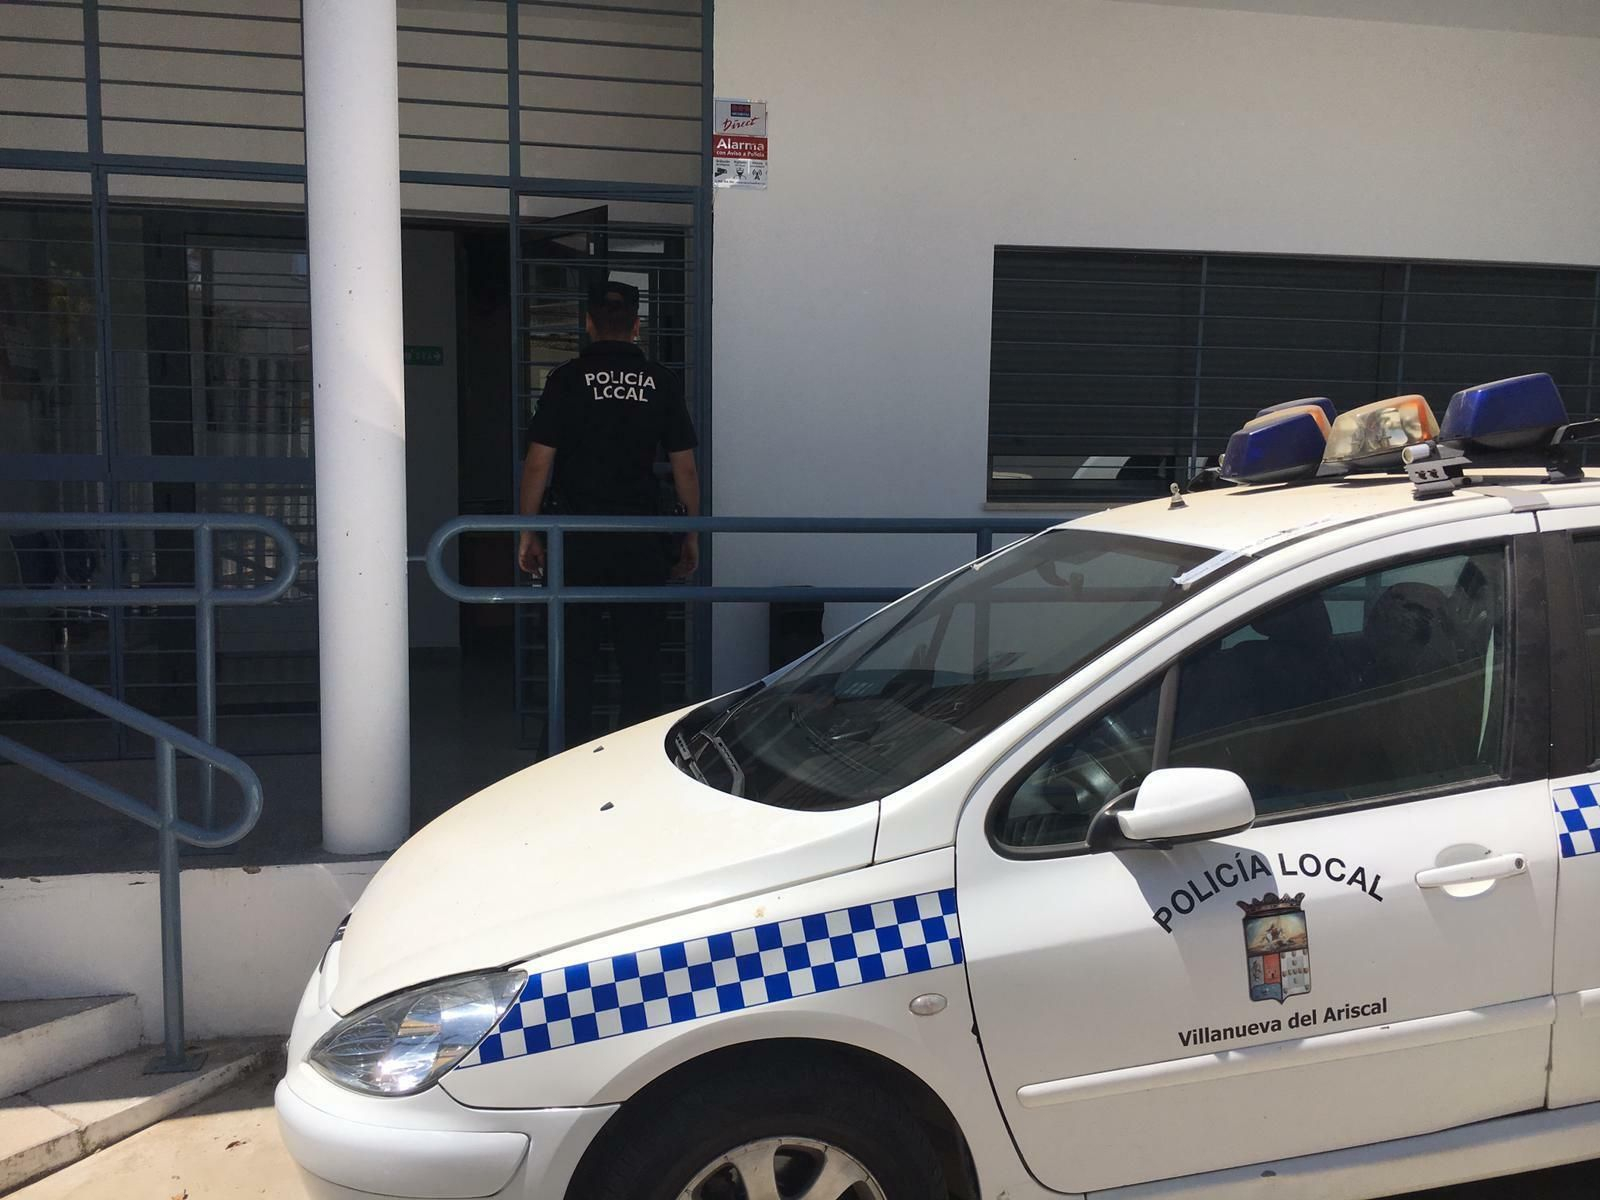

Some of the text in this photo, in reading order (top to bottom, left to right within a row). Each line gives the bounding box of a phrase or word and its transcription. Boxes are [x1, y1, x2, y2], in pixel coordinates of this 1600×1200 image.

[722, 117, 760, 131] Direct
[716, 138, 765, 151] Alarma
[584, 370, 656, 390] POLICÍA
[1152, 852, 1384, 934] POLICÍA LOCAL
[1178, 997, 1387, 1047] Villanueva del Ariscal
